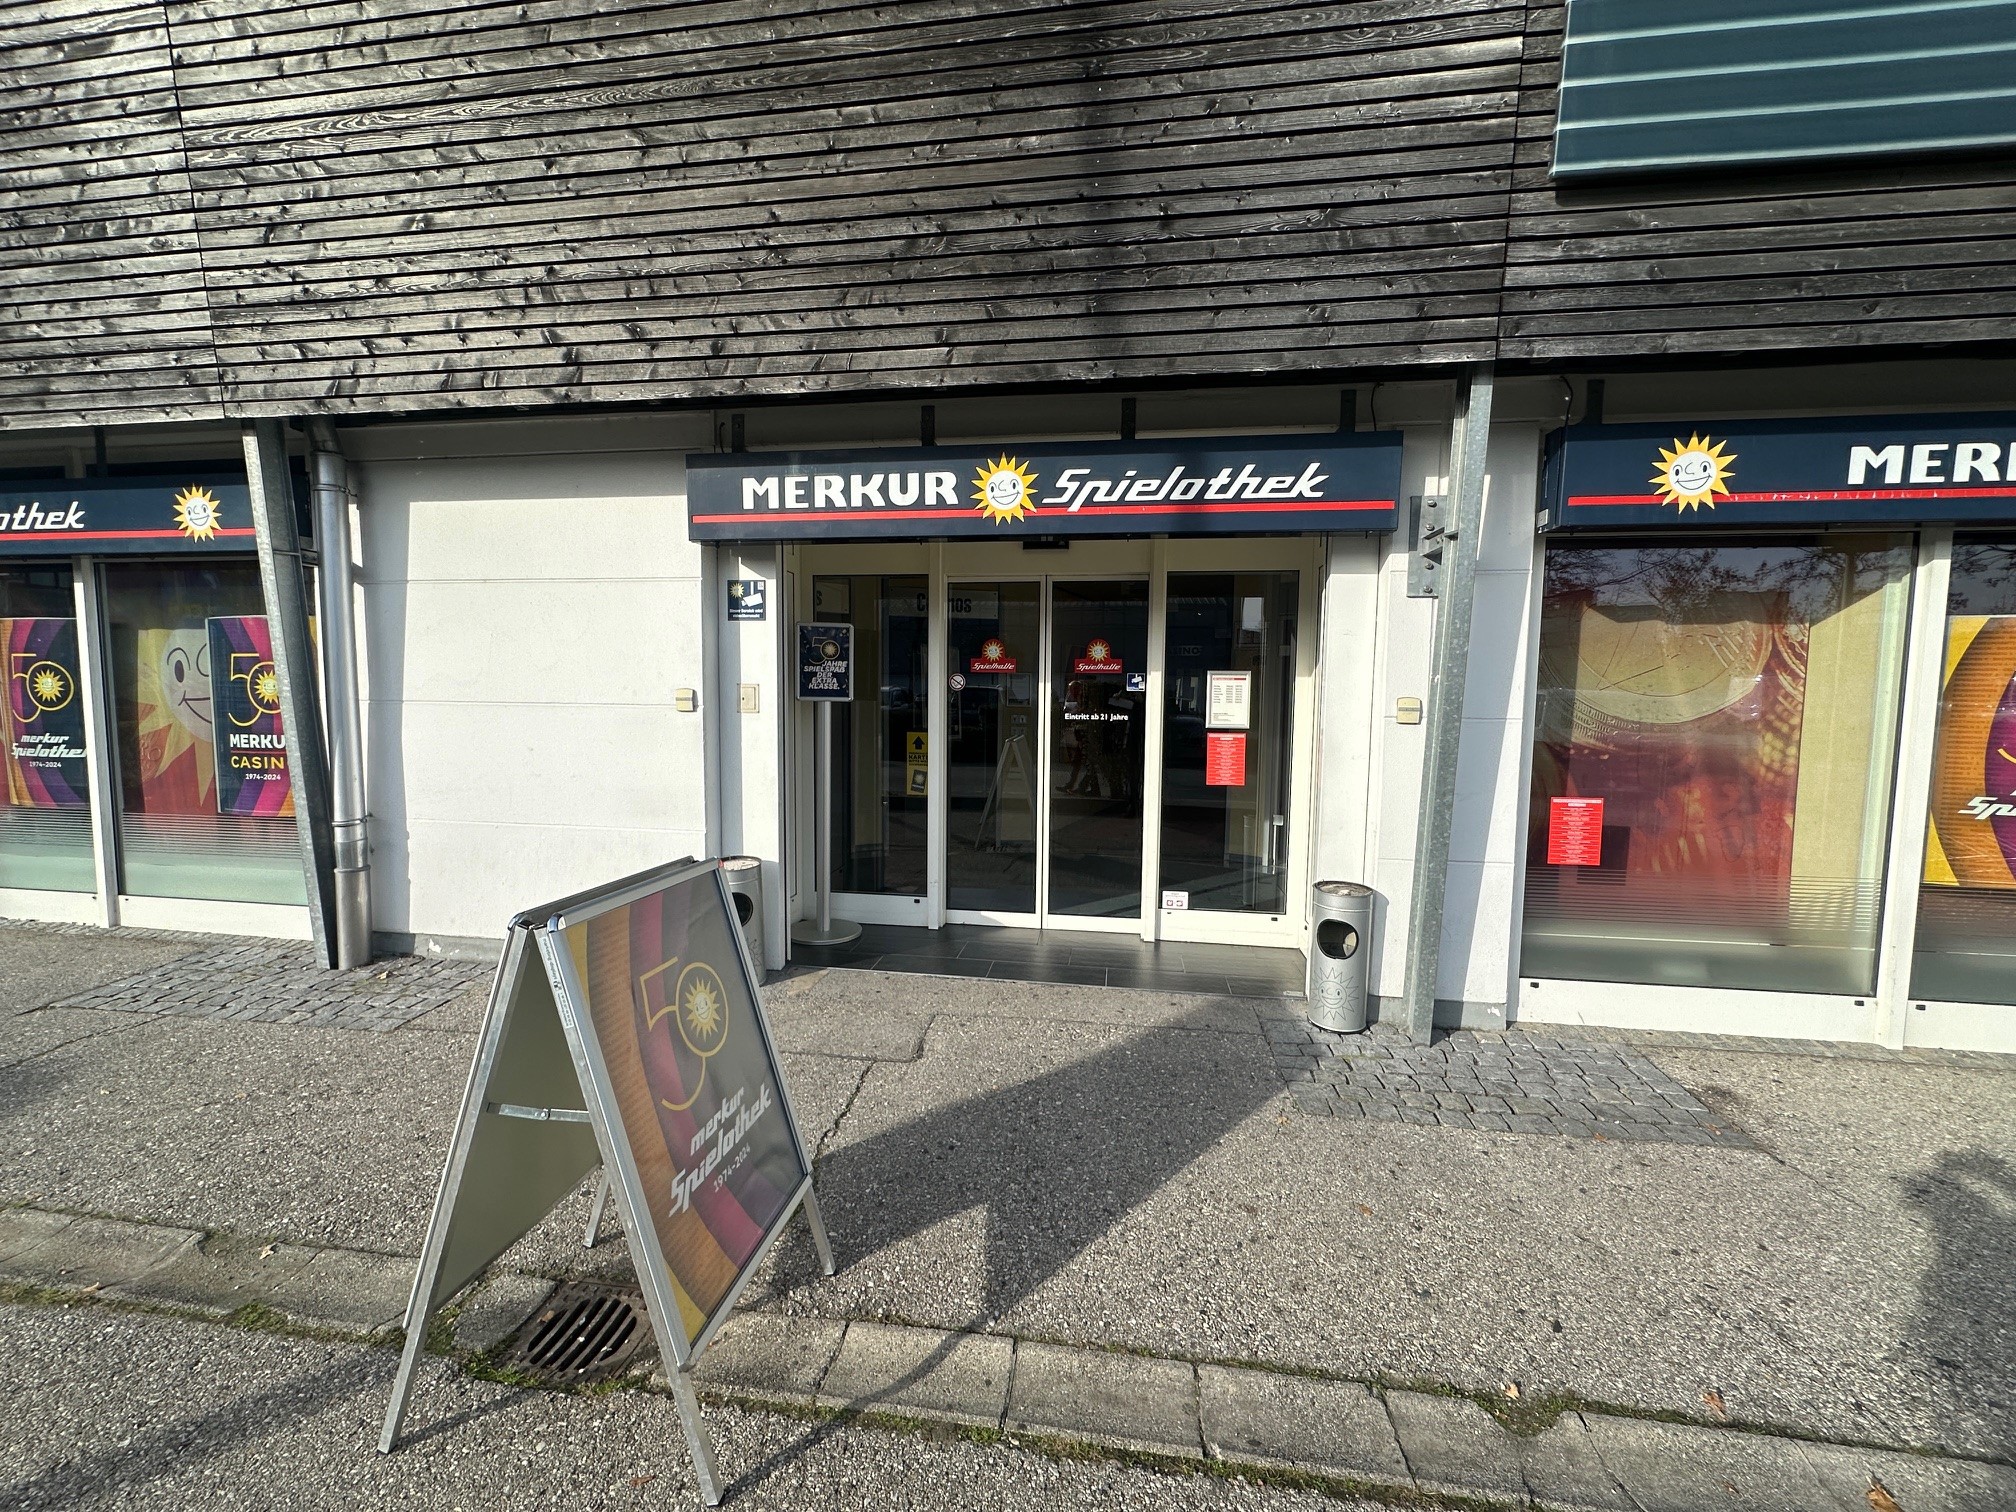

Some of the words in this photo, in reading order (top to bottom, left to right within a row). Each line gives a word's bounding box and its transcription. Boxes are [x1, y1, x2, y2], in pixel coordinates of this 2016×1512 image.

[1847, 442, 2016, 484] MER
[742, 471, 959, 510] MERKUR
[1041, 462, 1330, 513] Spielothek
[972, 662, 1015, 671] Spielhalle
[1076, 663, 1121, 672] Spielhalle
[1109, 713, 1129, 721] Jahre
[21, 732, 70, 743] merkur
[29, 761, 62, 769] 1974-2024
[690, 1086, 744, 1156] merkur
[668, 1082, 772, 1218] Spielothek
[713, 1142, 751, 1193] 1974-2024
